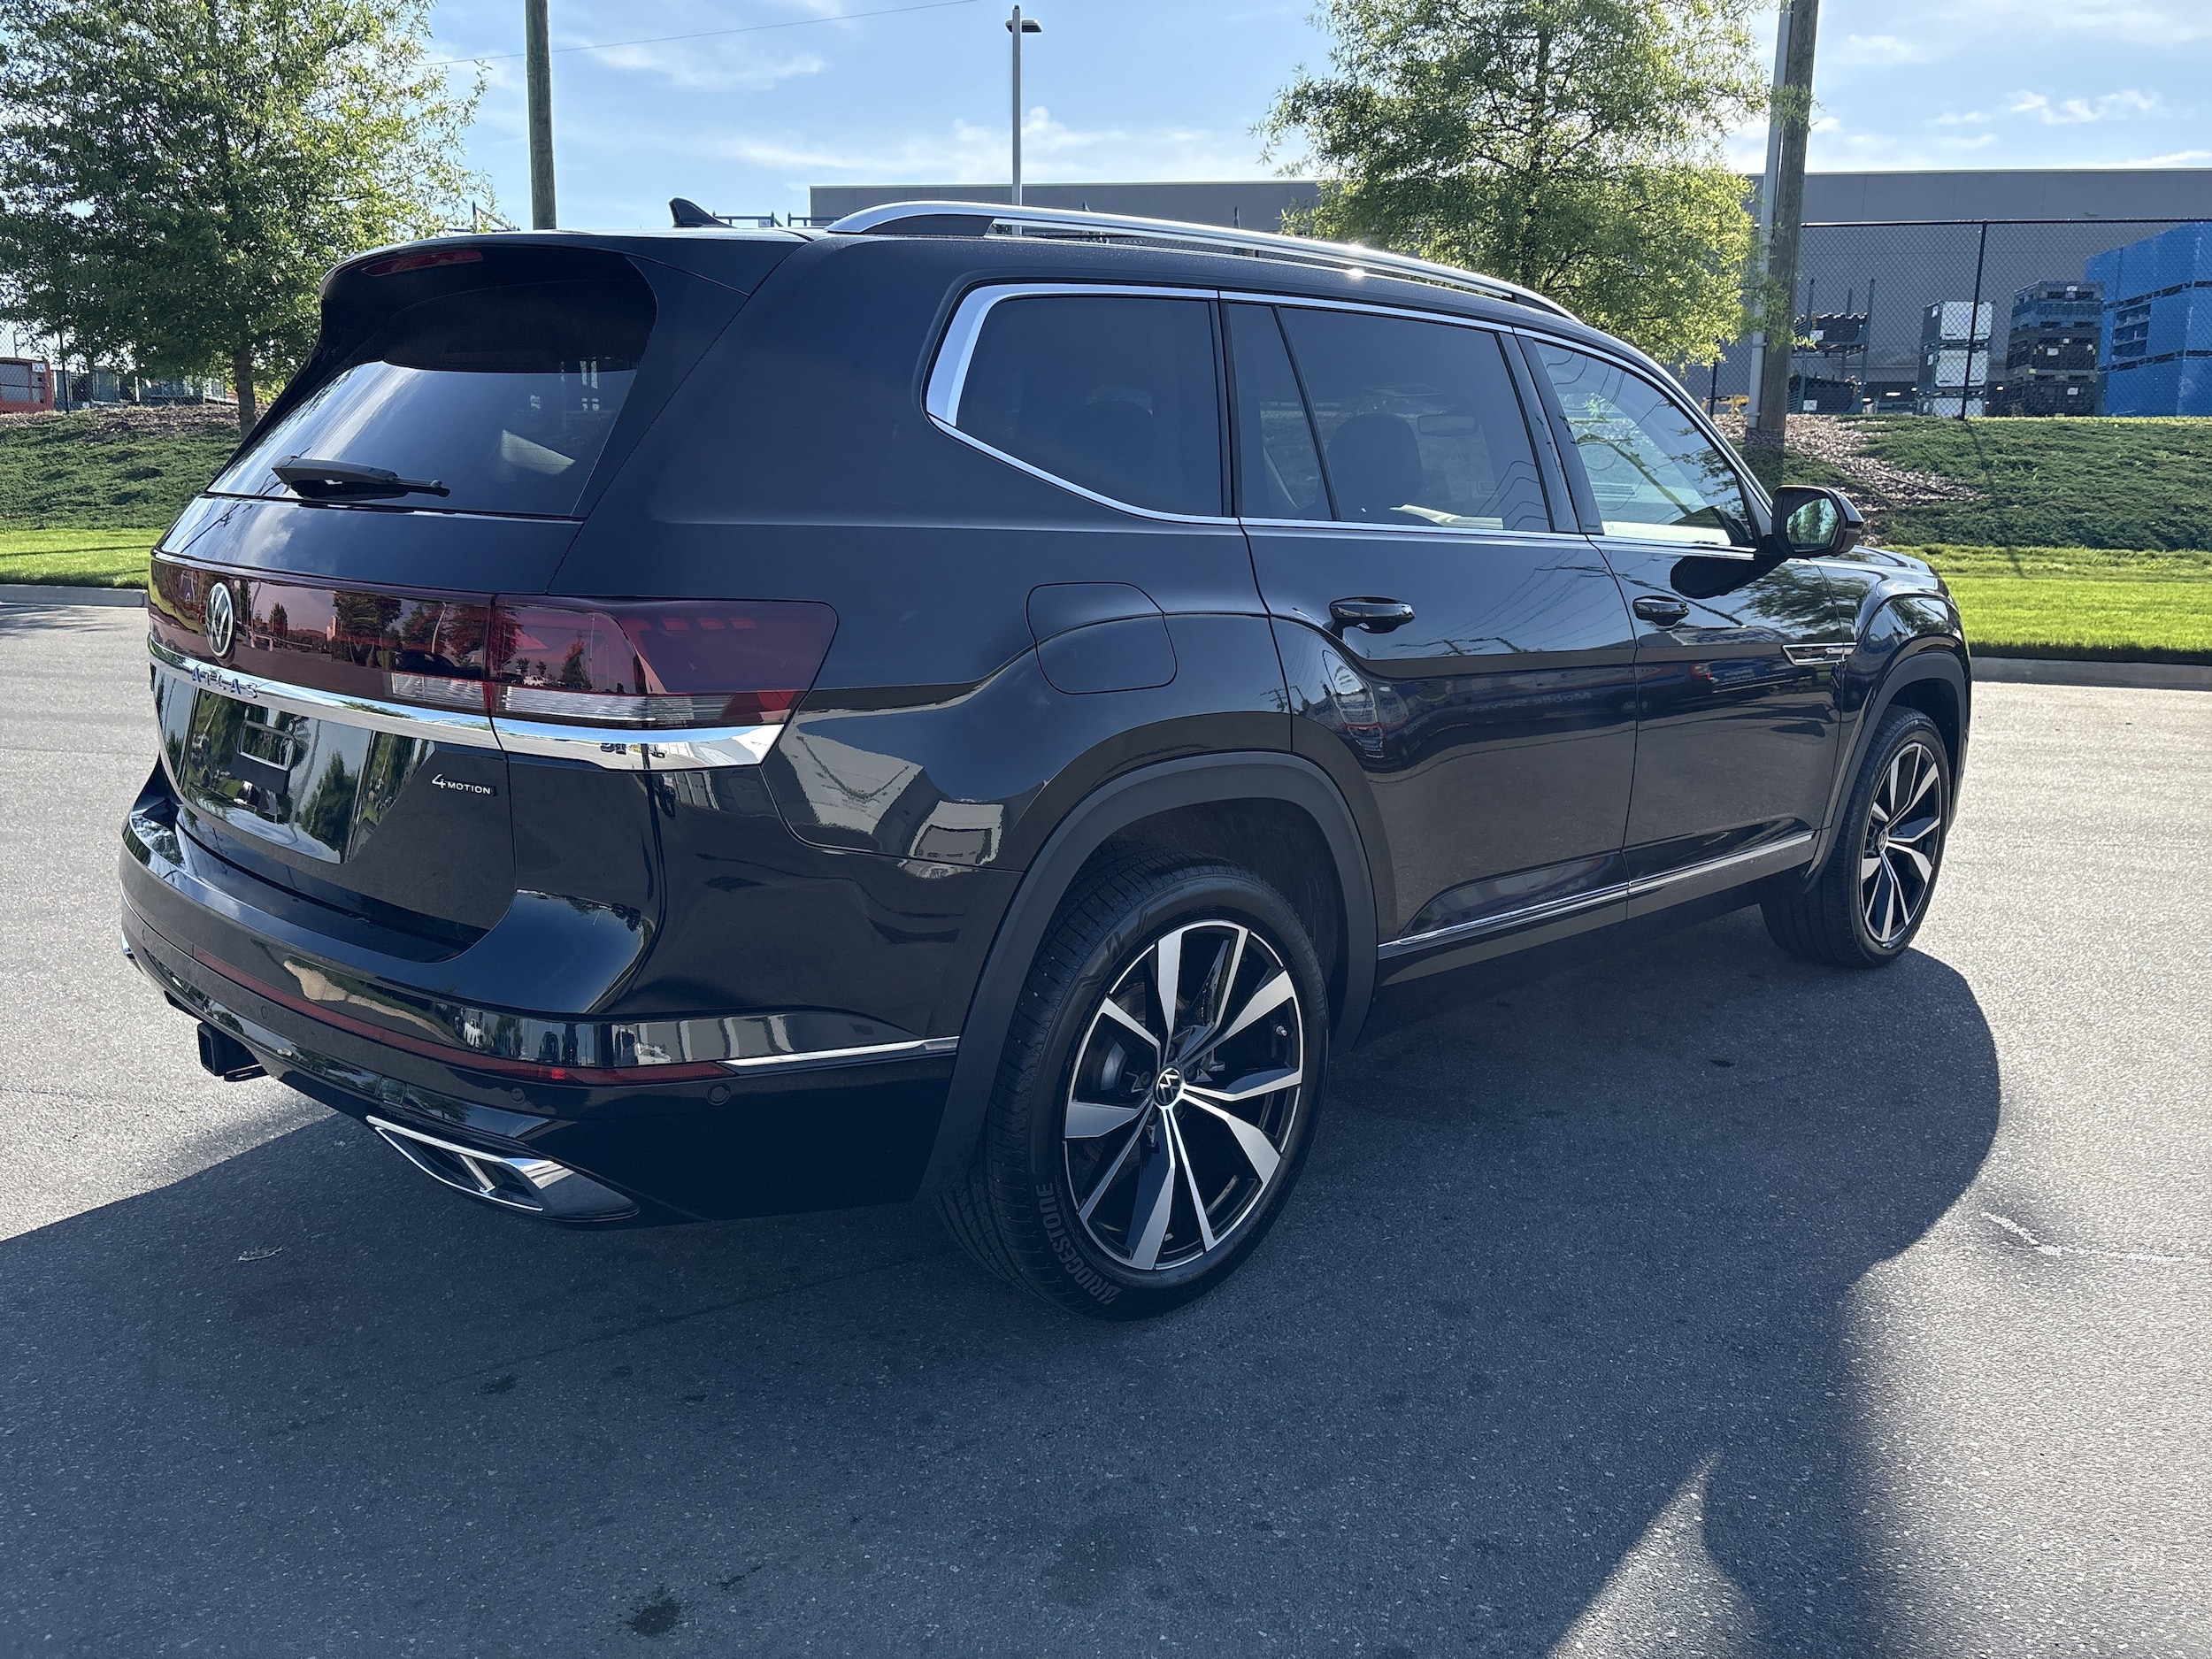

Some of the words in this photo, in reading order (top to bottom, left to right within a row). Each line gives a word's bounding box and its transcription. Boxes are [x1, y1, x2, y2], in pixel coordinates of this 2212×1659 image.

[191, 666, 257, 698] ATLAS
[432, 772, 491, 795] 4MOTION
[1035, 1181, 1123, 1306] BRIDGESTONE
